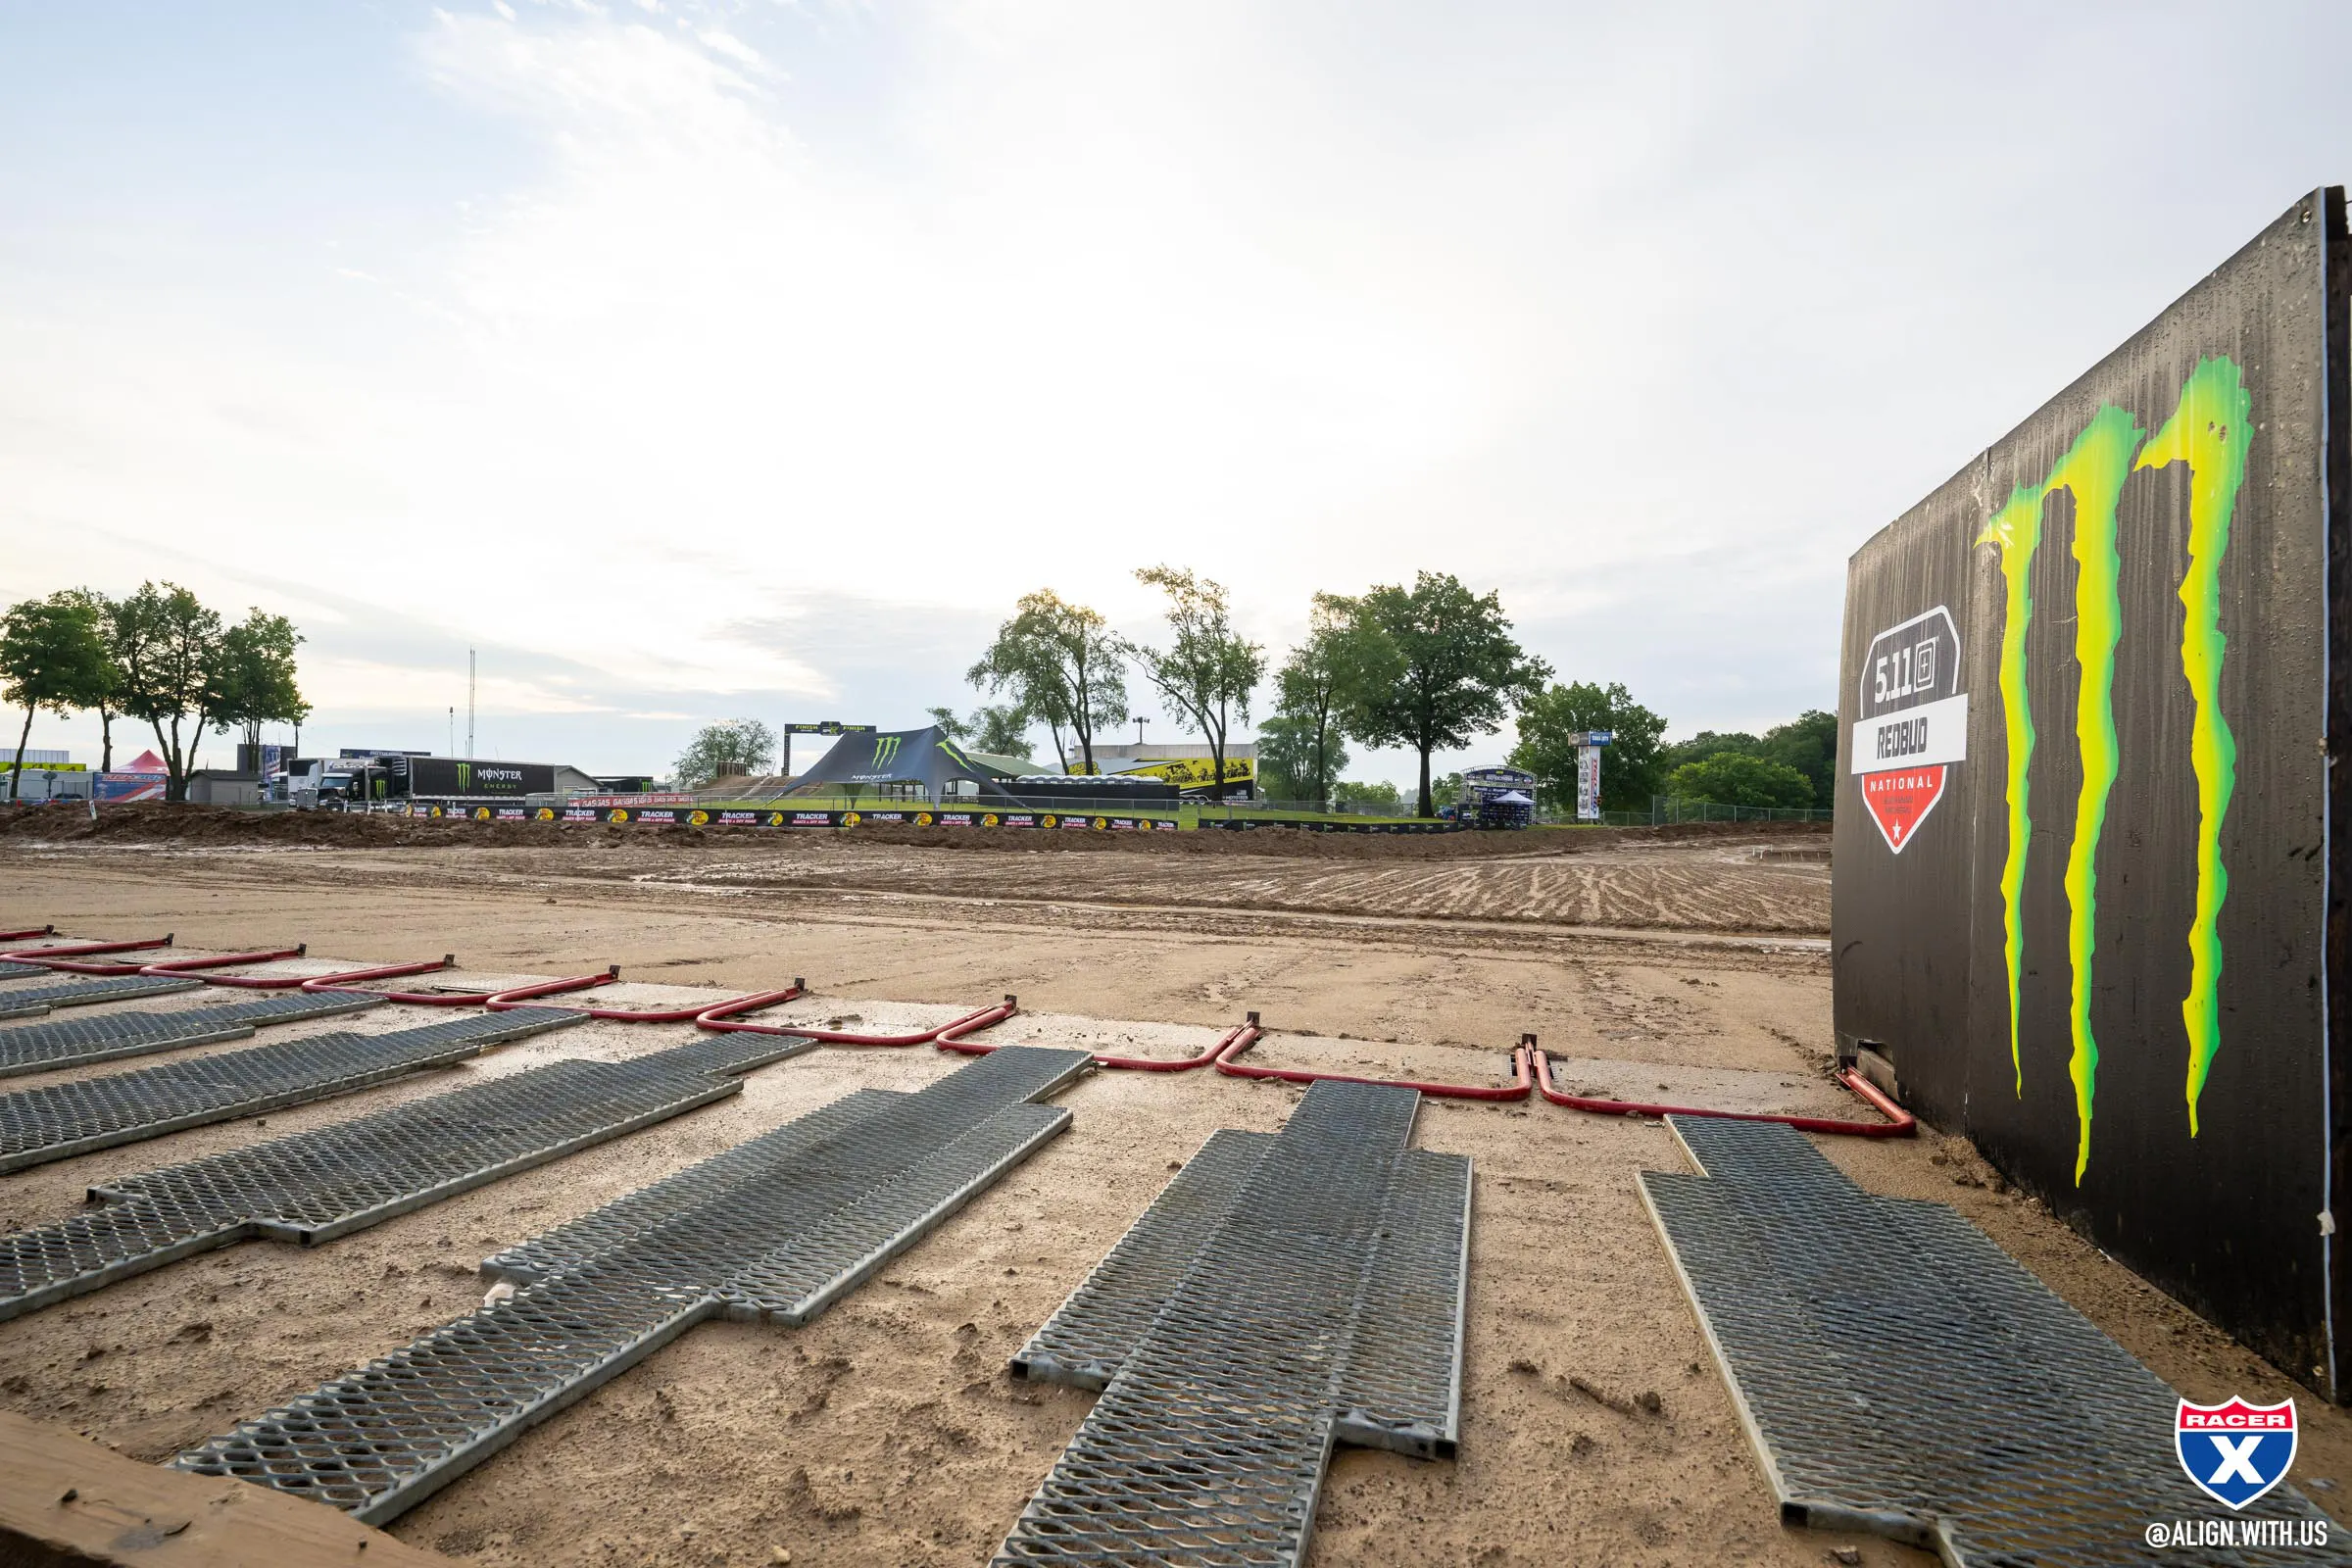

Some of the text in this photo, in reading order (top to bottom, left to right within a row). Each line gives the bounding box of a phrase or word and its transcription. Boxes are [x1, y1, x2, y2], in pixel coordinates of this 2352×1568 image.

[1874, 647, 1912, 704] 5.11
[1877, 717, 1929, 760] REDBUD
[477, 768, 522, 781] MONSTER
[1870, 775, 1934, 793] NATIONAL
